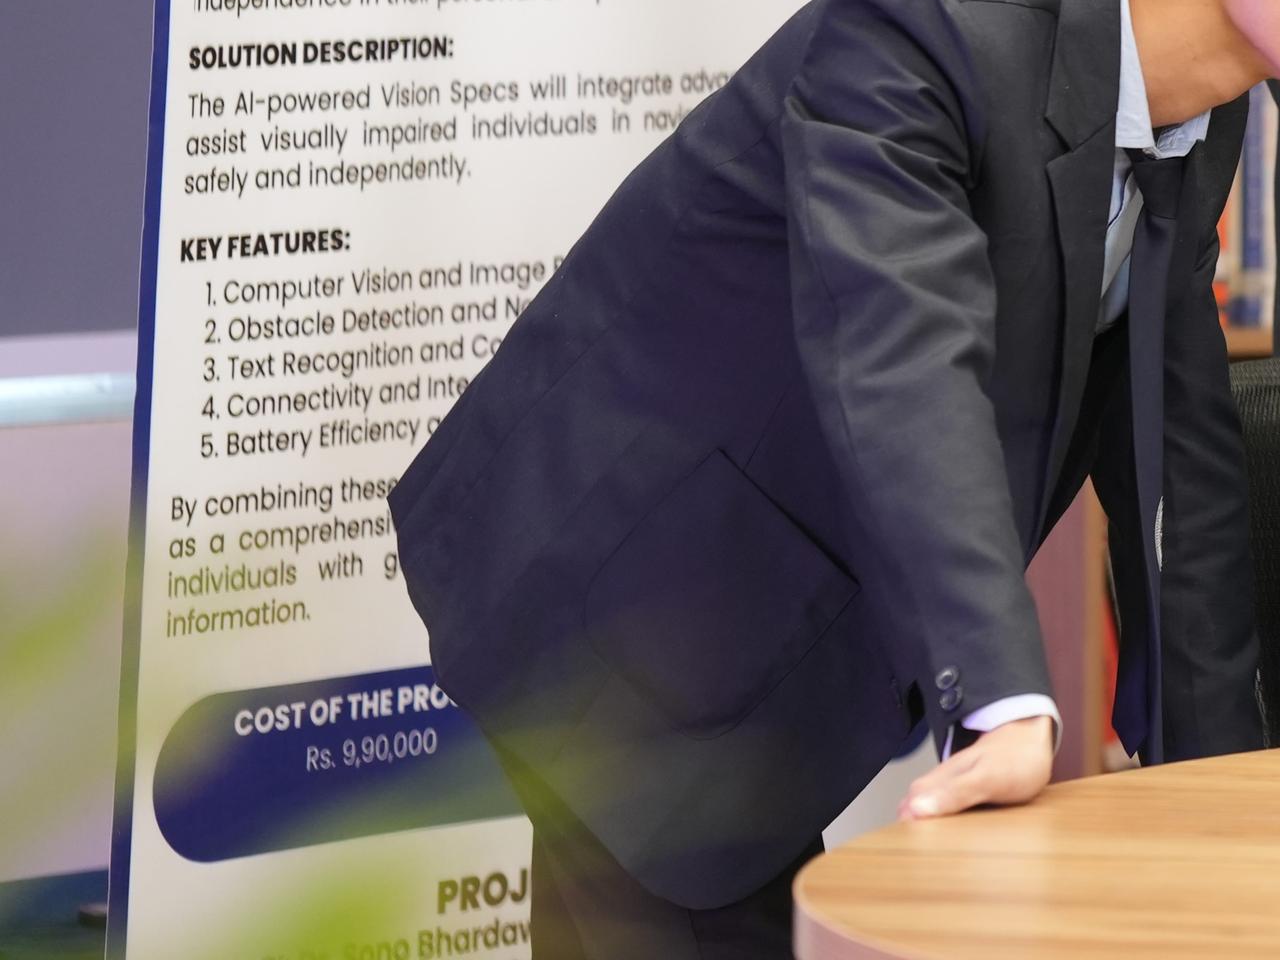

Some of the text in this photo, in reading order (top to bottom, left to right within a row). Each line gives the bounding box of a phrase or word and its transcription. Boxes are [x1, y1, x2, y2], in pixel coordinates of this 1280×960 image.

[189, 36, 453, 70] SOLUTION DESCRIPTION:
[189, 73, 673, 122] The AI-powered Vision Specs will integrate
[186, 128, 246, 156] assist
[261, 124, 347, 155] visually
[364, 116, 456, 152] impaired
[472, 111, 597, 139] individuals
[612, 108, 630, 132] in
[185, 154, 470, 198] safely and independently.
[181, 229, 350, 262] KEY FEATURES:
[206, 261, 546, 308] 1. Computer Vision and Image
[205, 319, 221, 344] 2.
[228, 311, 335, 342] Obstacle
[343, 302, 443, 333] Detection
[451, 296, 497, 324] and
[203, 357, 219, 382] 3.
[228, 354, 274, 379] Text
[283, 341, 413, 378] Recognition
[420, 335, 464, 363] and
[202, 395, 219, 419] 4.
[227, 382, 373, 418] Connectivity
[379, 376, 420, 404] and
[201, 418, 420, 458] 5. Battery Efficiency
[172, 496, 197, 527] By
[205, 482, 333, 517] combining
[169, 537, 195, 559] as
[210, 534, 224, 554] a
[168, 559, 296, 598] individuals
[318, 552, 363, 580] with
[167, 598, 310, 637] information.
[235, 681, 458, 735] COST OF THE PRO
[306, 728, 438, 773] Rs. 9,90,000
